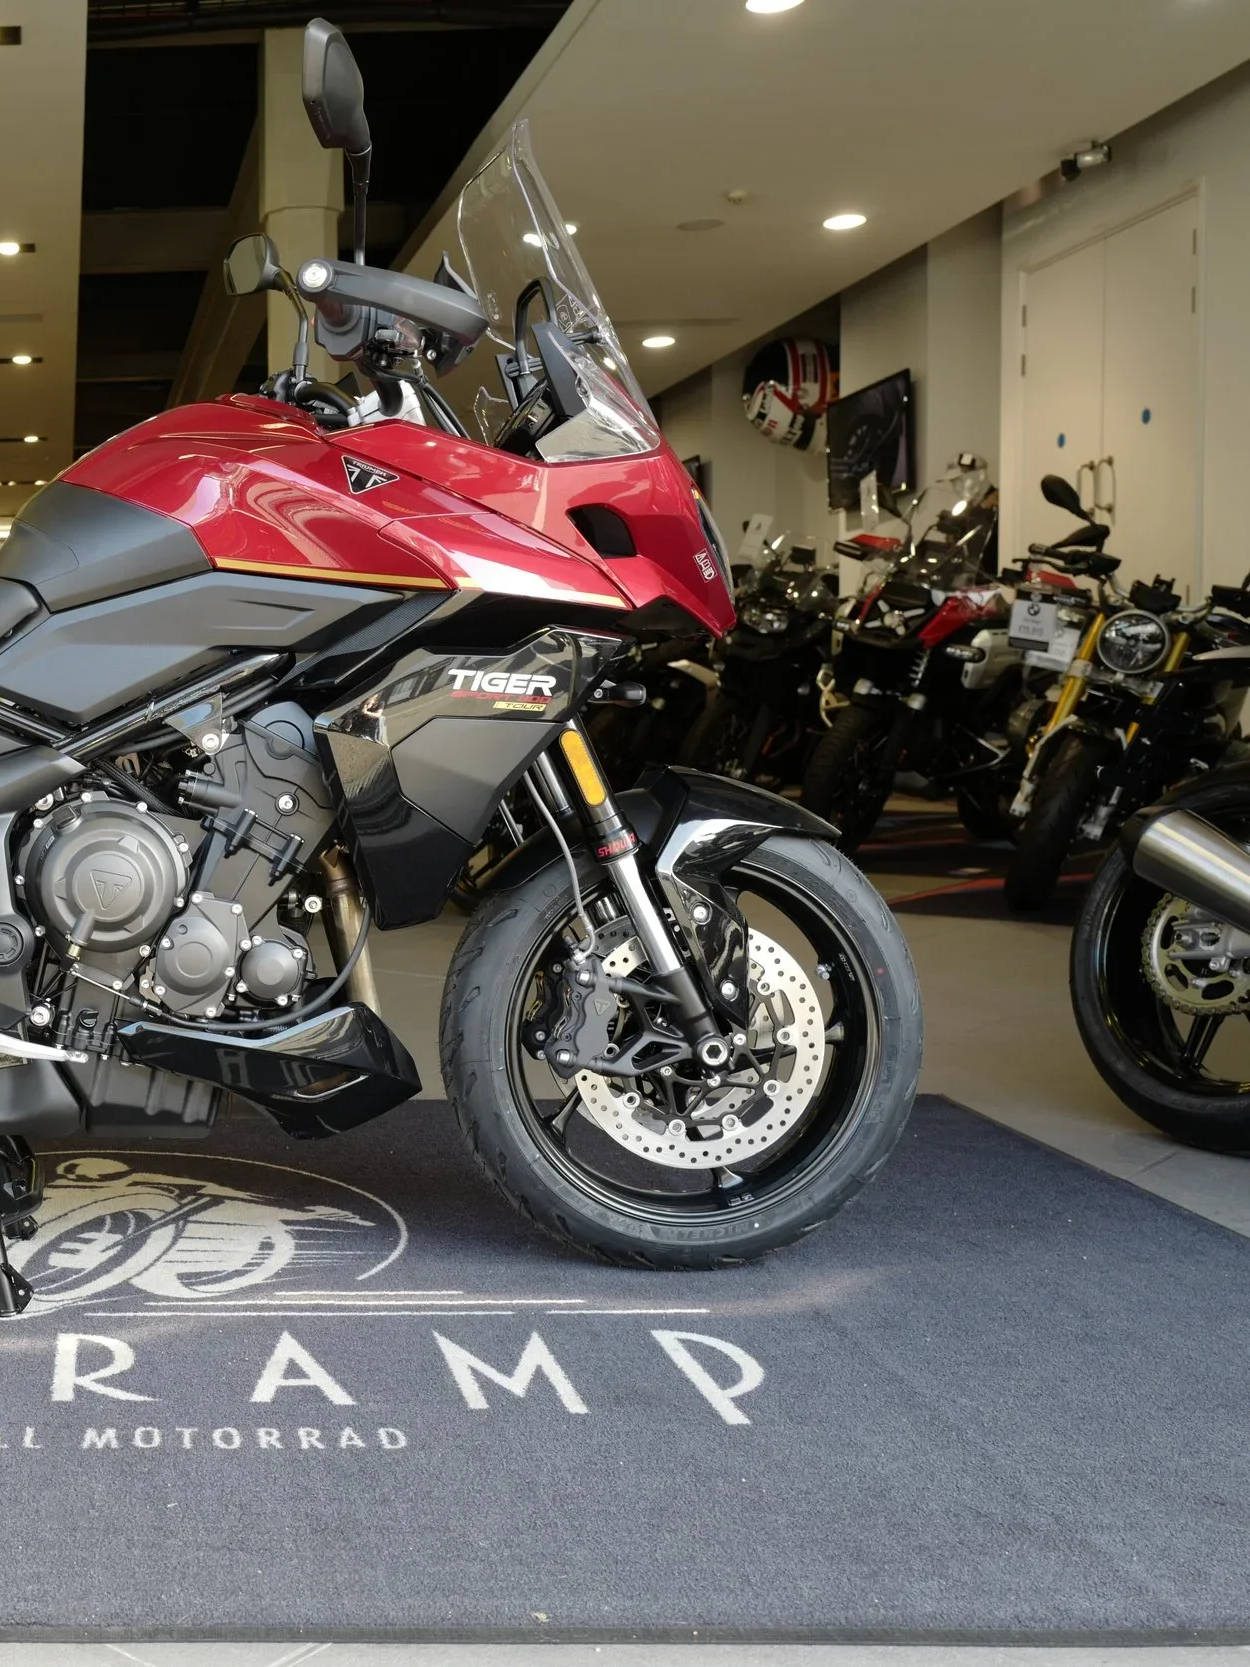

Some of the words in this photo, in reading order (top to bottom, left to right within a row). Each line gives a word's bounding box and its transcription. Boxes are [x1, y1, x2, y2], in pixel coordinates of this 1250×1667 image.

[352, 460, 387, 477] TRIUMPH
[448, 668, 556, 697] TIGER
[450, 690, 510, 701] SPORT
[505, 702, 543, 711] TOUR
[597, 832, 637, 858] SHOWA
[50, 1330, 766, 1426] RAMP
[82, 1426, 408, 1450] MOTORRAD
